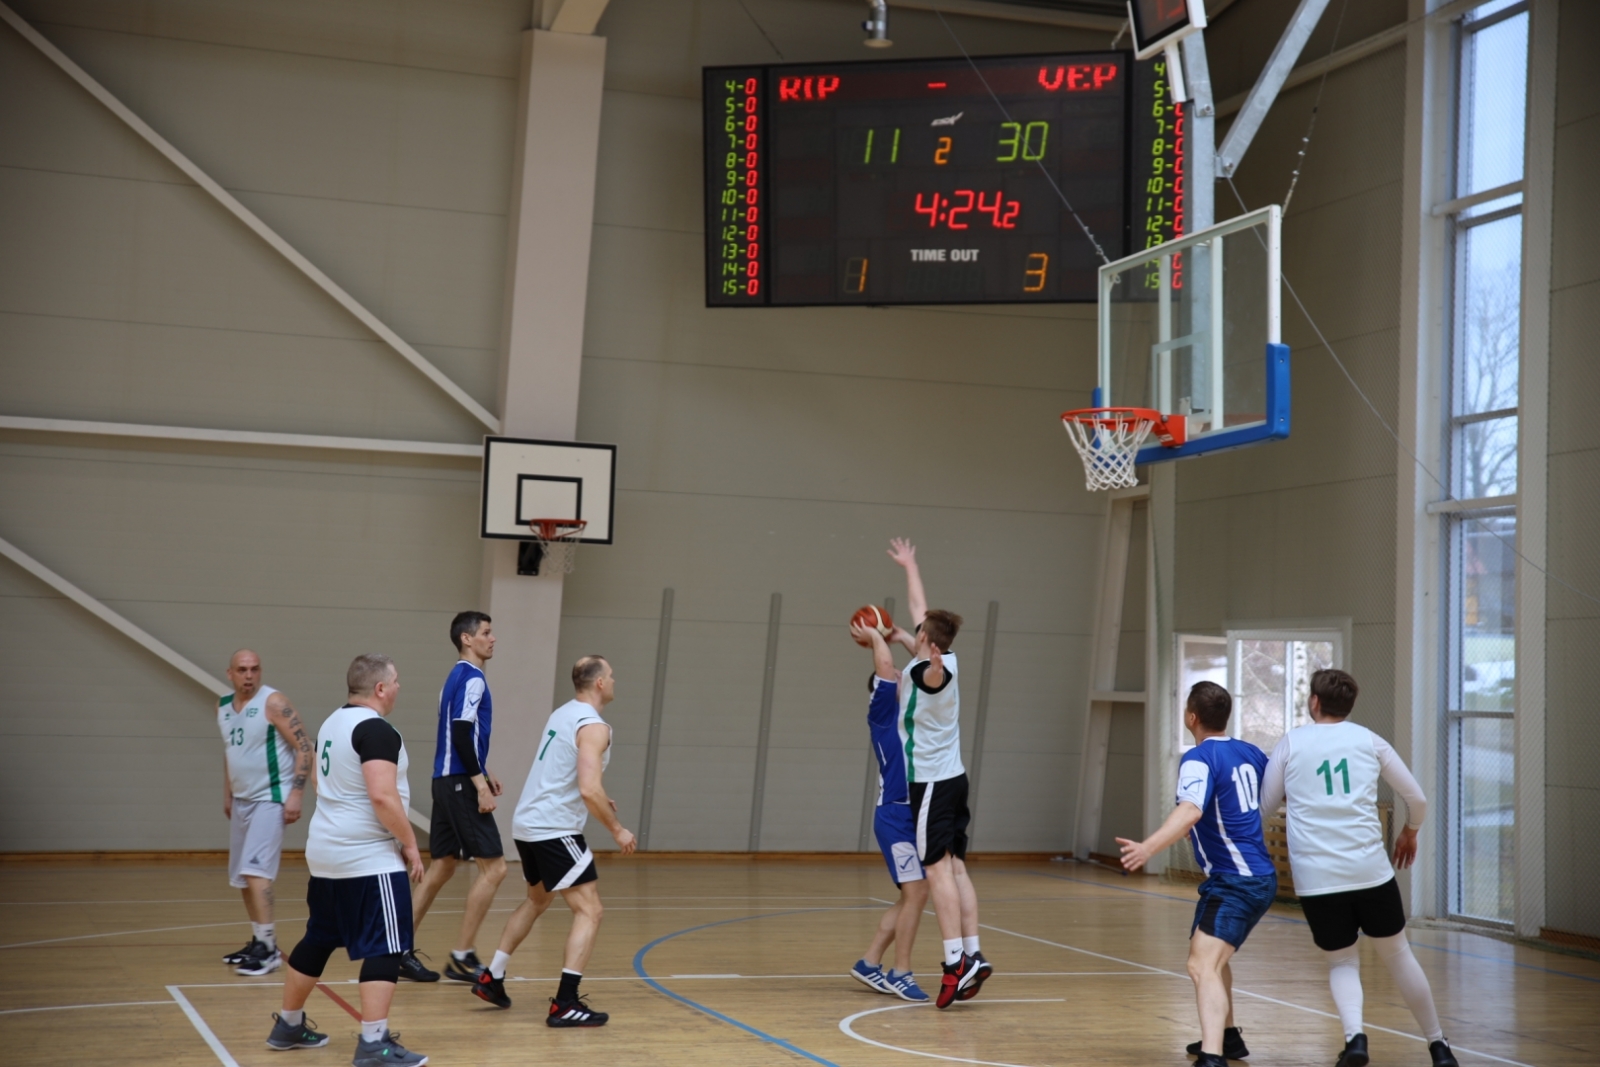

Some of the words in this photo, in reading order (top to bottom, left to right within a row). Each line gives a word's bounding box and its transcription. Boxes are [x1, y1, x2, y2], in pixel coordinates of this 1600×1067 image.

[864, 128, 900, 164] 11
[996, 121, 1049, 162] 30
[934, 137, 952, 165] 2
[911, 249, 946, 262] TIME
[950, 249, 979, 262] OUT
[1023, 253, 1048, 292] 3
[230, 727, 244, 746] 13
[539, 729, 556, 761] 7
[321, 739, 332, 777] 5
[1316, 758, 1350, 795] 11
[1231, 763, 1258, 813] 10
